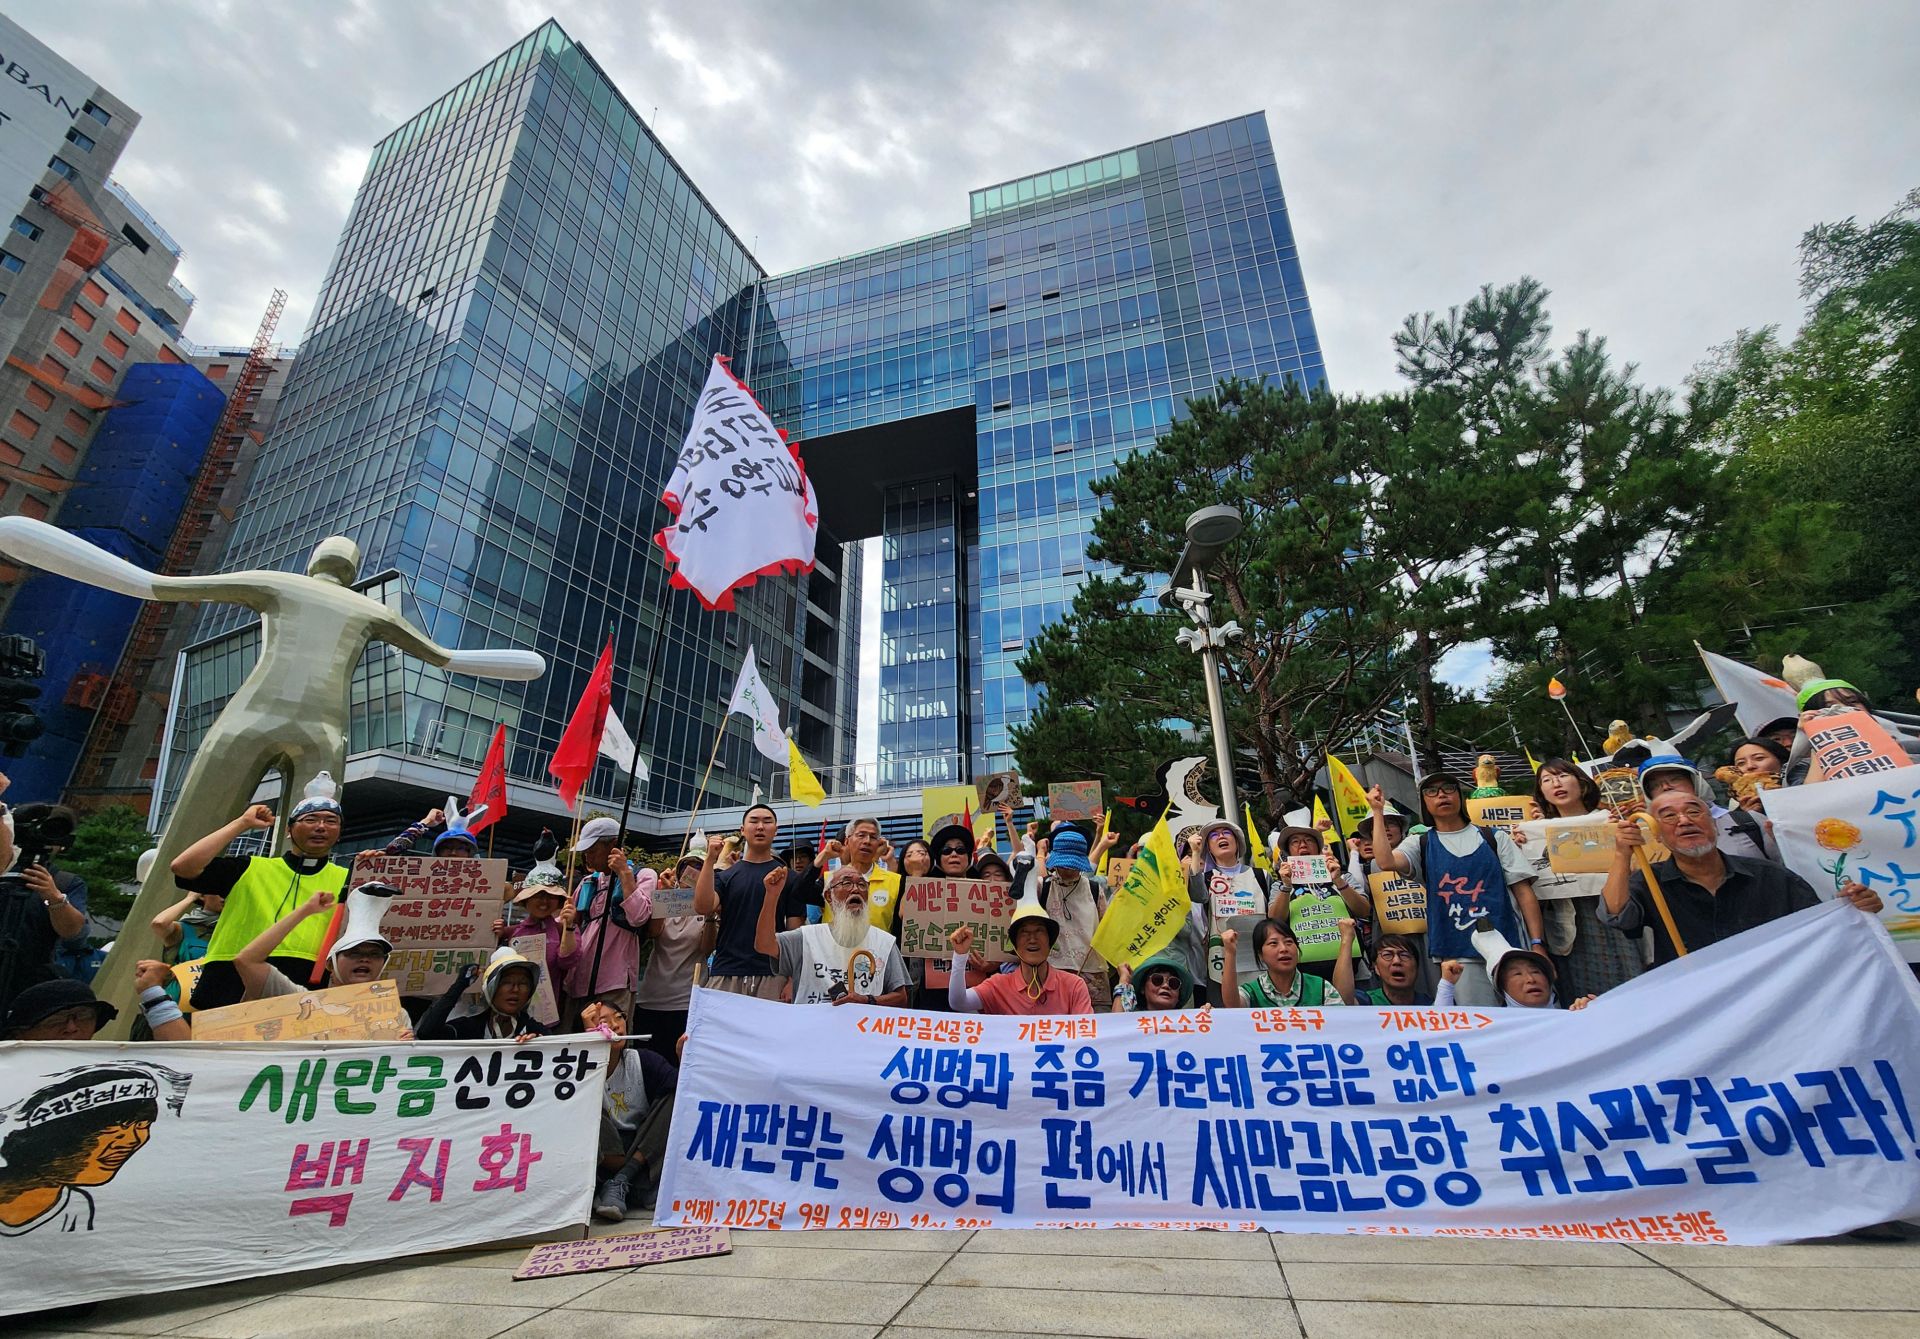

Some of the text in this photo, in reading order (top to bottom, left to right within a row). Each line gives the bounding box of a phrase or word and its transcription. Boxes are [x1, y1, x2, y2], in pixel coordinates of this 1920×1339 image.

[0, 53, 80, 120] BAN
[1481, 807, 1524, 820] 새만금
[1868, 789, 1920, 849] 수
[355, 857, 423, 875] 새만금
[906, 881, 960, 912] 새만금
[1300, 904, 1334, 918] 법원은
[1386, 892, 1425, 908] 신공항
[1296, 931, 1342, 945] 취소판결하
[1018, 1018, 1097, 1042] 기본계획
[1136, 1011, 1213, 1034] 취소소송
[1250, 1010, 1326, 1033] 인용촉구
[880, 1041, 1501, 1110] 생명과 죽음 가운데 중립은 없다.
[31, 1081, 158, 1124] 수라살려보자!
[686, 1059, 1920, 1214] 재판부는 생명의 편에서 새만금신공항 취소판결하라!
[727, 1200, 787, 1230] 2025년
[799, 1203, 830, 1229] 9월
